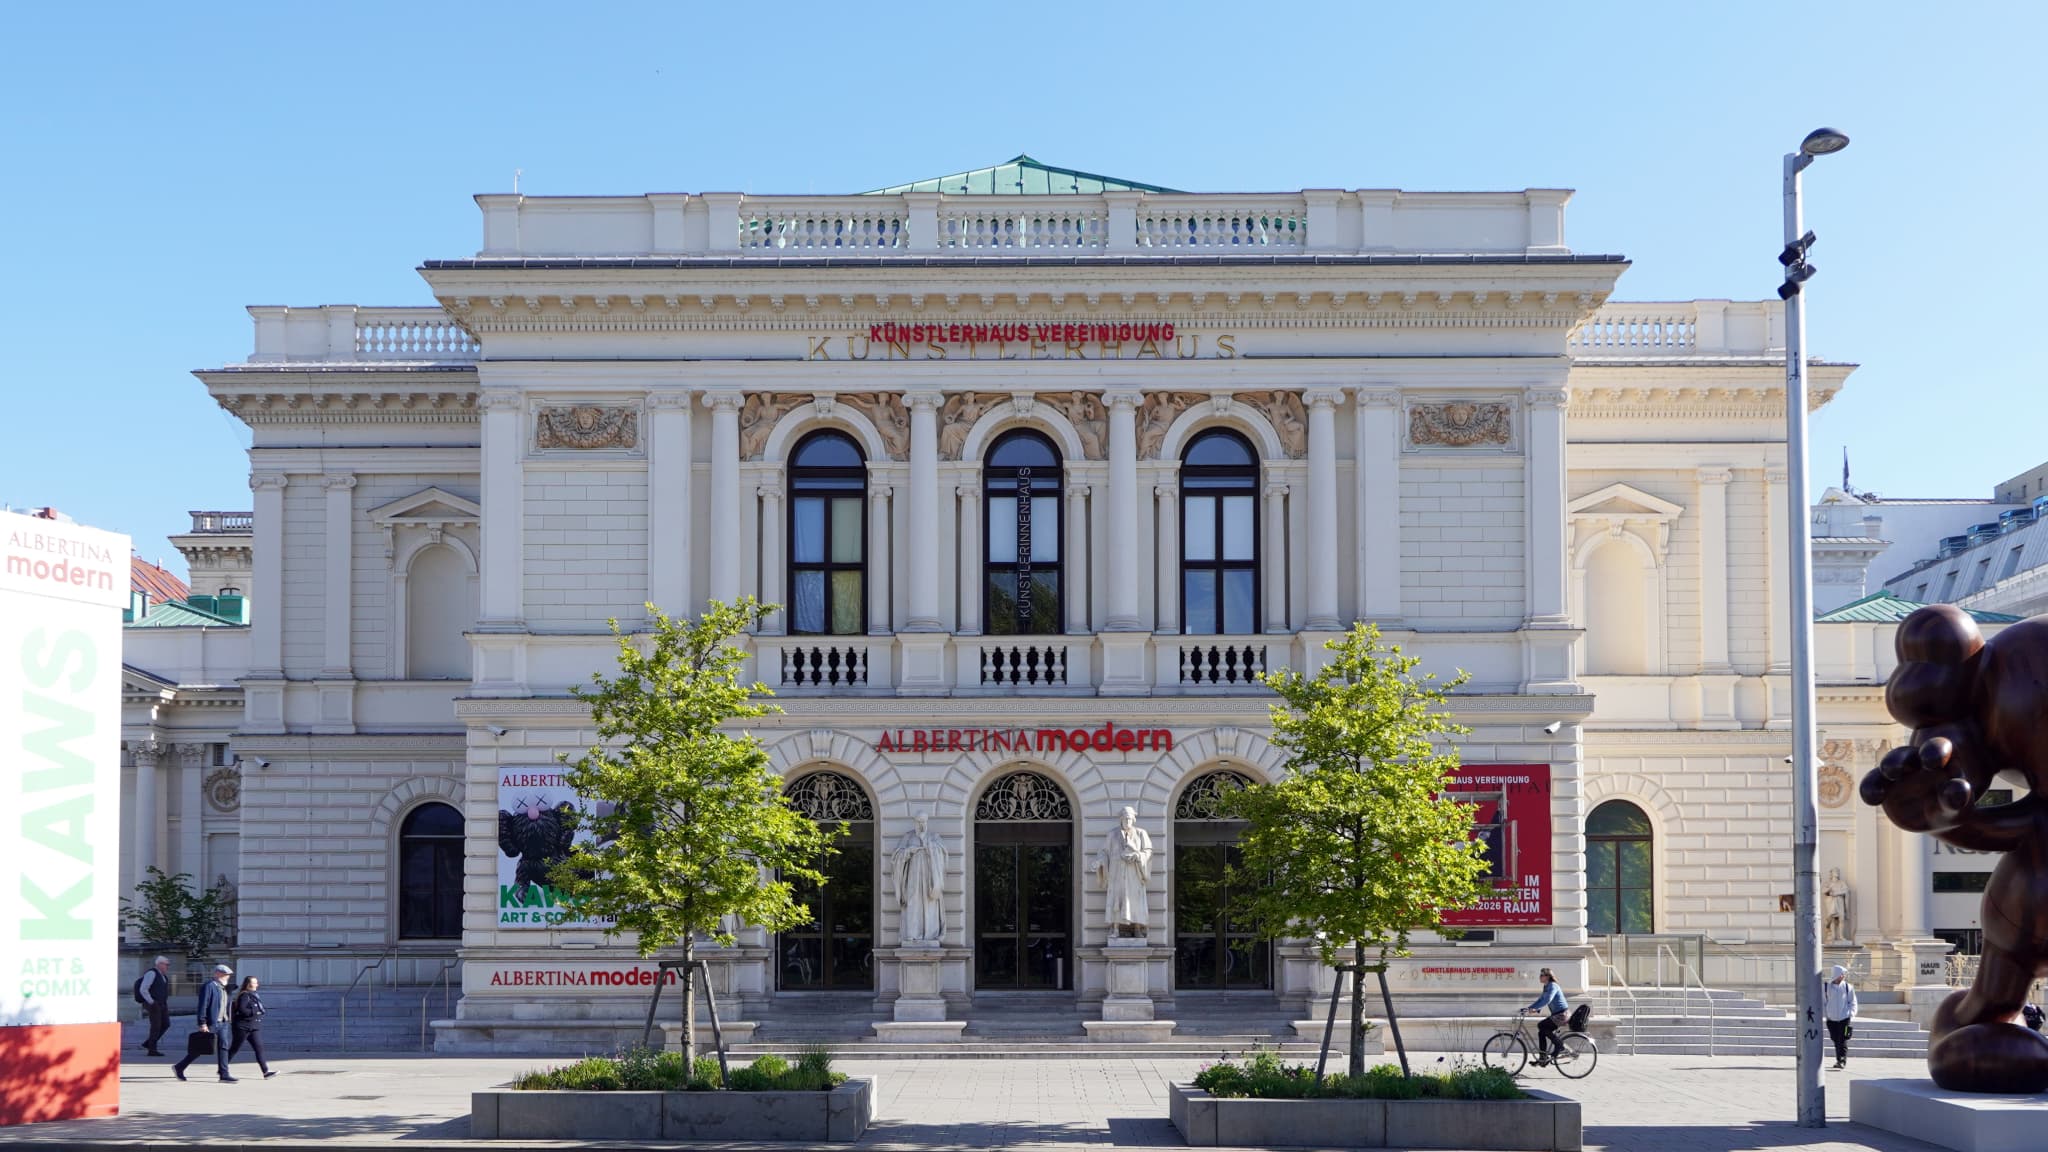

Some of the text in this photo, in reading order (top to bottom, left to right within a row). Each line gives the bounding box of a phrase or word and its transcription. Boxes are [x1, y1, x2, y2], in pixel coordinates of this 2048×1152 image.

[870, 322, 1174, 343] KÜNSTLERHAUS VEREINIGUNG
[8, 530, 113, 564] ALBERTINA
[7, 555, 113, 591] modern
[876, 722, 1173, 753] ALBERTINA modern
[20, 627, 98, 940] KAWS
[502, 774, 568, 787] ALBERTI
[1475, 775, 1530, 784] VEREINIGUNG
[1524, 874, 1540, 887] IM
[500, 911, 528, 923] ART
[531, 911, 543, 923] &
[1503, 901, 1540, 914] RAUM
[22, 957, 84, 975] ART &
[490, 967, 676, 986] ALBERTINA modern
[20, 978, 91, 998] COMIX
